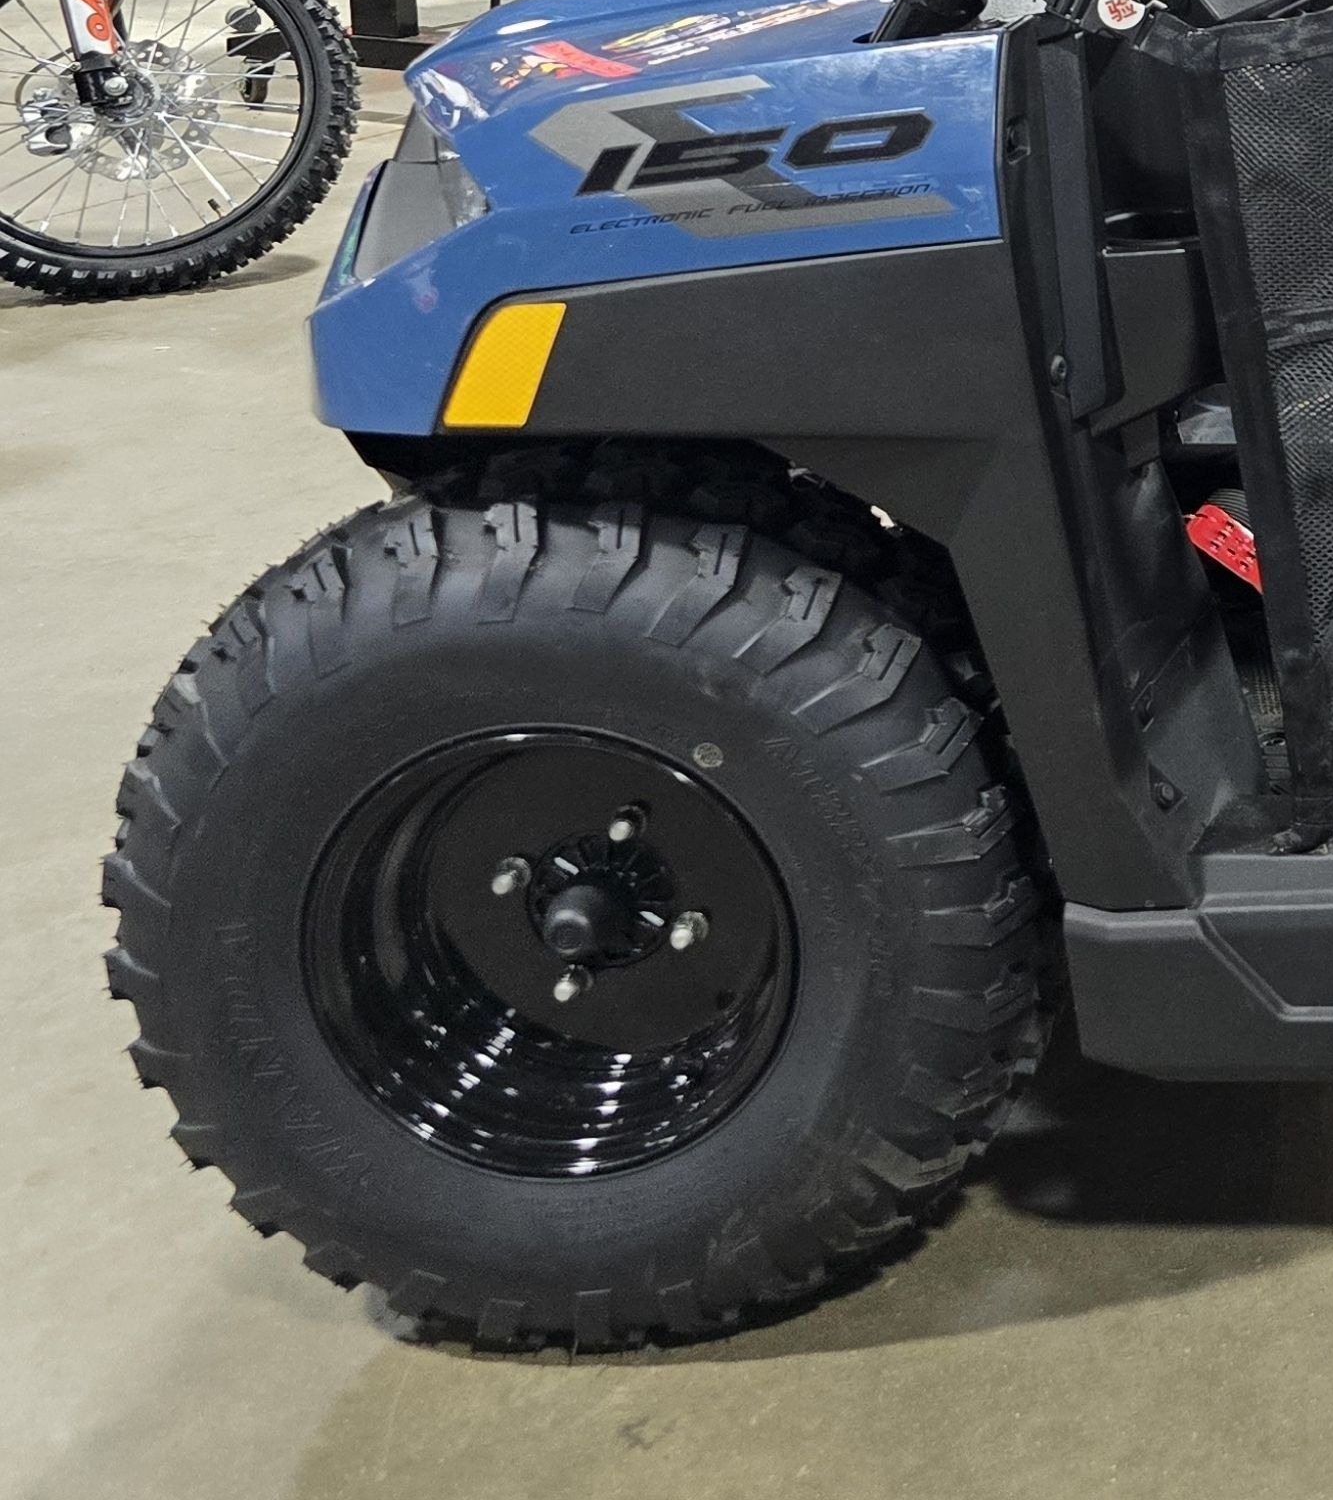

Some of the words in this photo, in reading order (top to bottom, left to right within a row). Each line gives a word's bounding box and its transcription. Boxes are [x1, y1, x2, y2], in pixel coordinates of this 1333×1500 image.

[575, 107, 937, 198] 150
[569, 207, 716, 236] ELECTRONIC
[728, 199, 797, 216] FUEL
[804, 183, 932, 206] INJECTION
